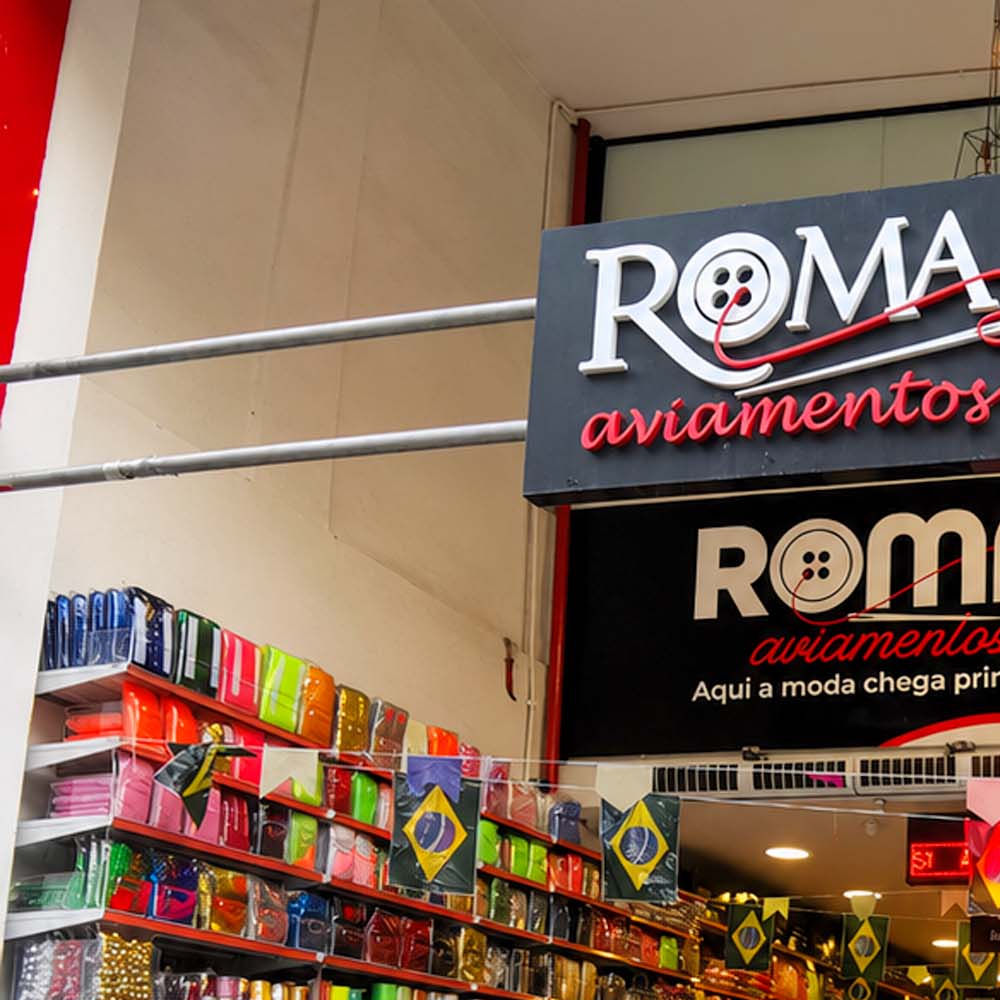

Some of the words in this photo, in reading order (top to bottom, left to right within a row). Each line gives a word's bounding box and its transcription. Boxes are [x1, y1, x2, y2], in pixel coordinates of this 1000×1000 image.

[580, 369, 993, 453] aviamentos
[691, 676, 752, 705] Aqui
[757, 681, 774, 699] a
[781, 673, 856, 698] moda
[863, 670, 946, 698] chega
